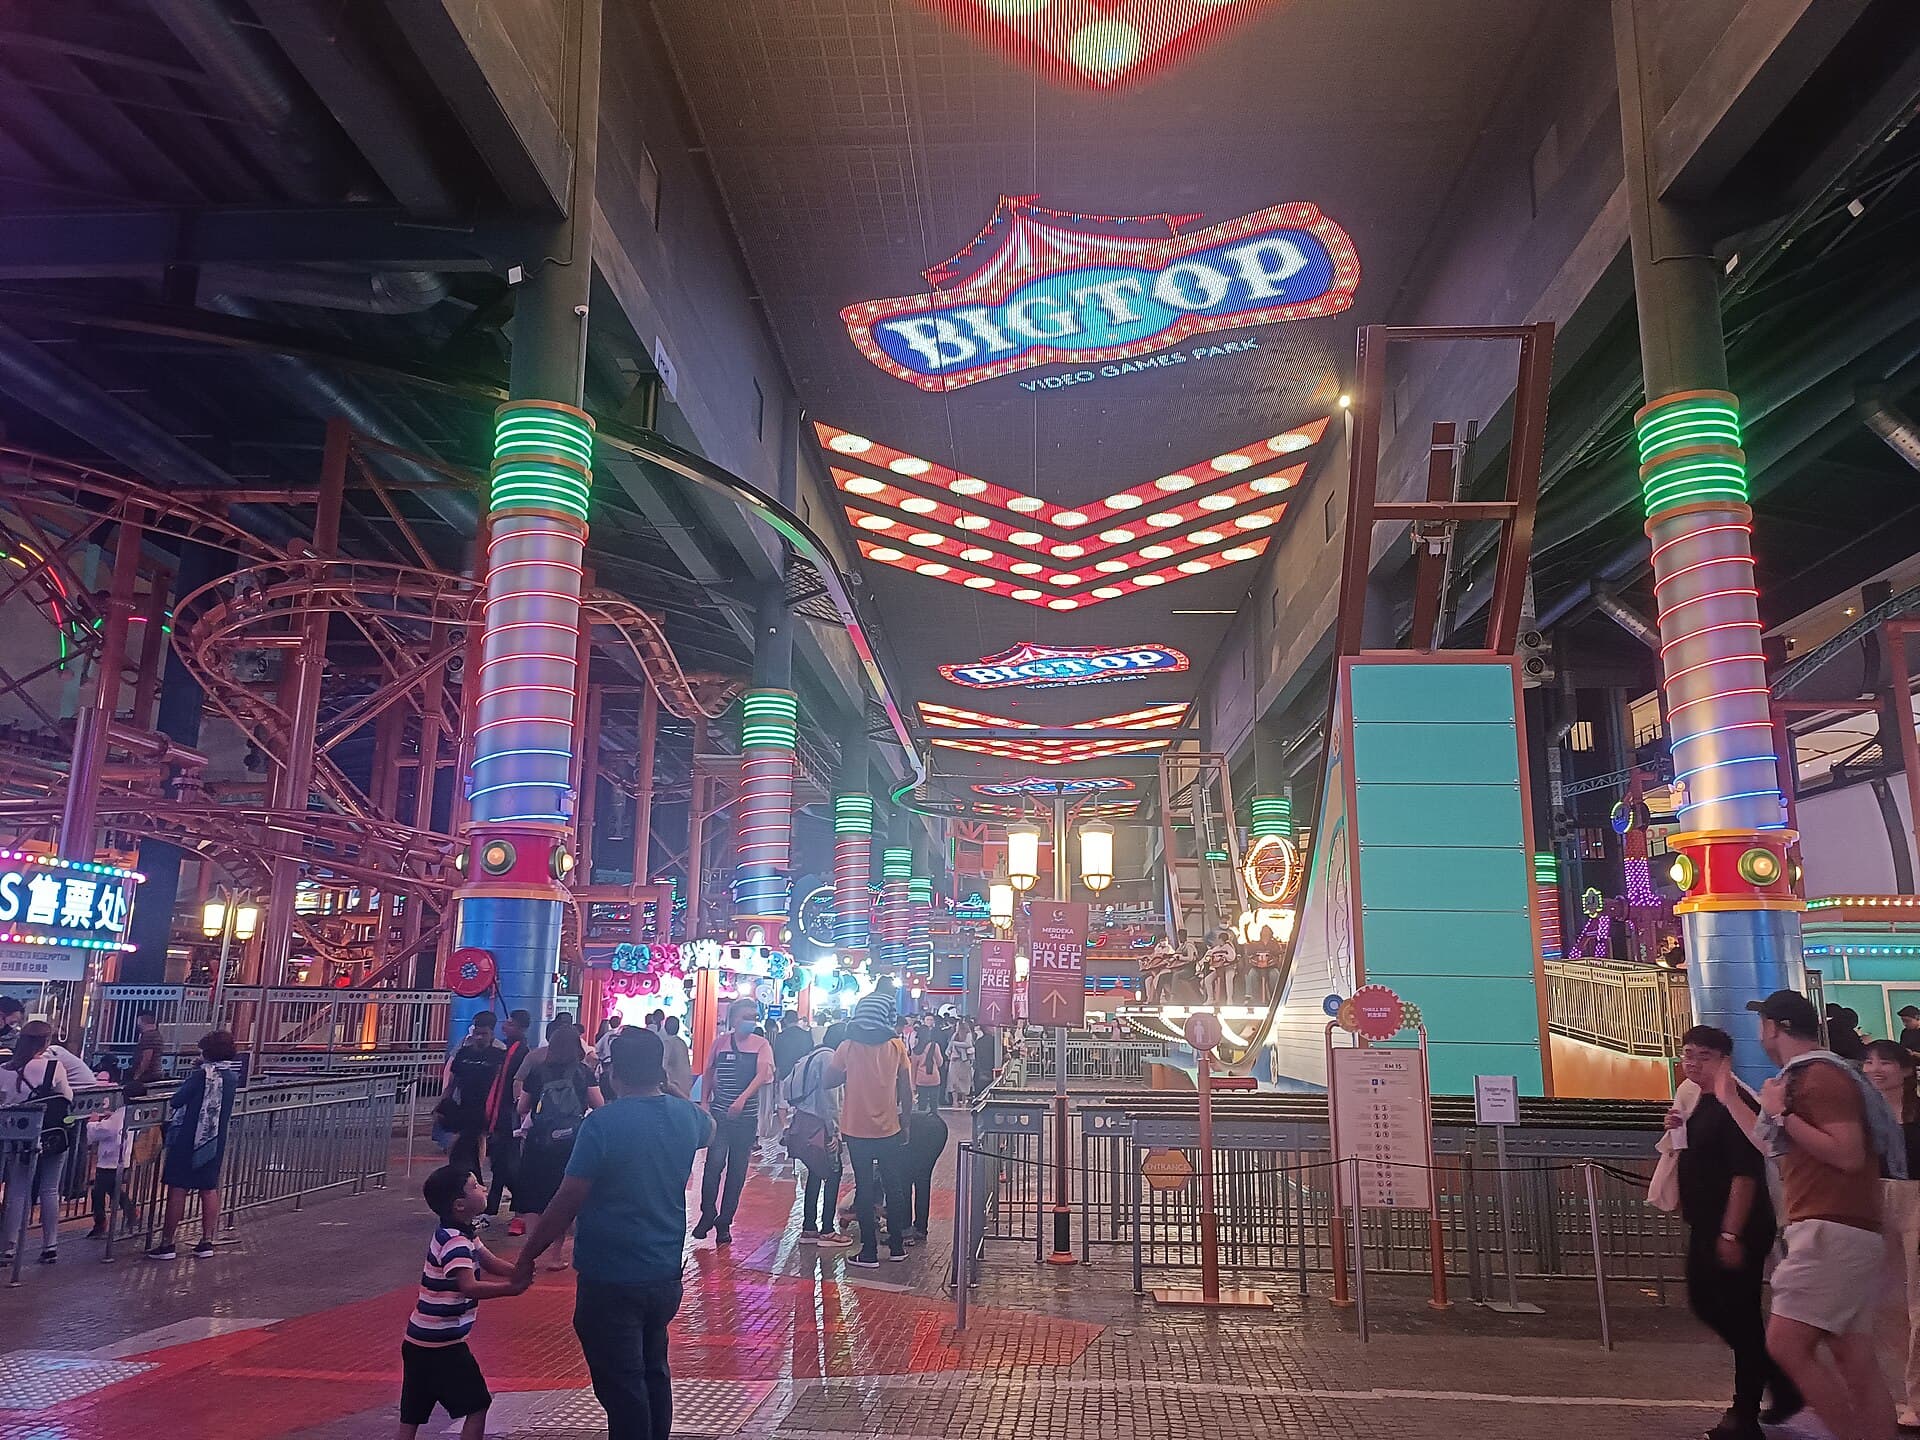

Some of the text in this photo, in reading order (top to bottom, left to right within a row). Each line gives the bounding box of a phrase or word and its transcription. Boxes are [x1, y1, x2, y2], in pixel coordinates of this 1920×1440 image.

[1019, 338, 1259, 393] VIDEO GAMES PARK
[1042, 927, 1074, 935] MERDEKA
[1032, 942, 1052, 950] BUY
[1032, 950, 1082, 970] FREE
[981, 974, 1010, 987] FREE
[1146, 1163, 1188, 1171] ENTRANCE
